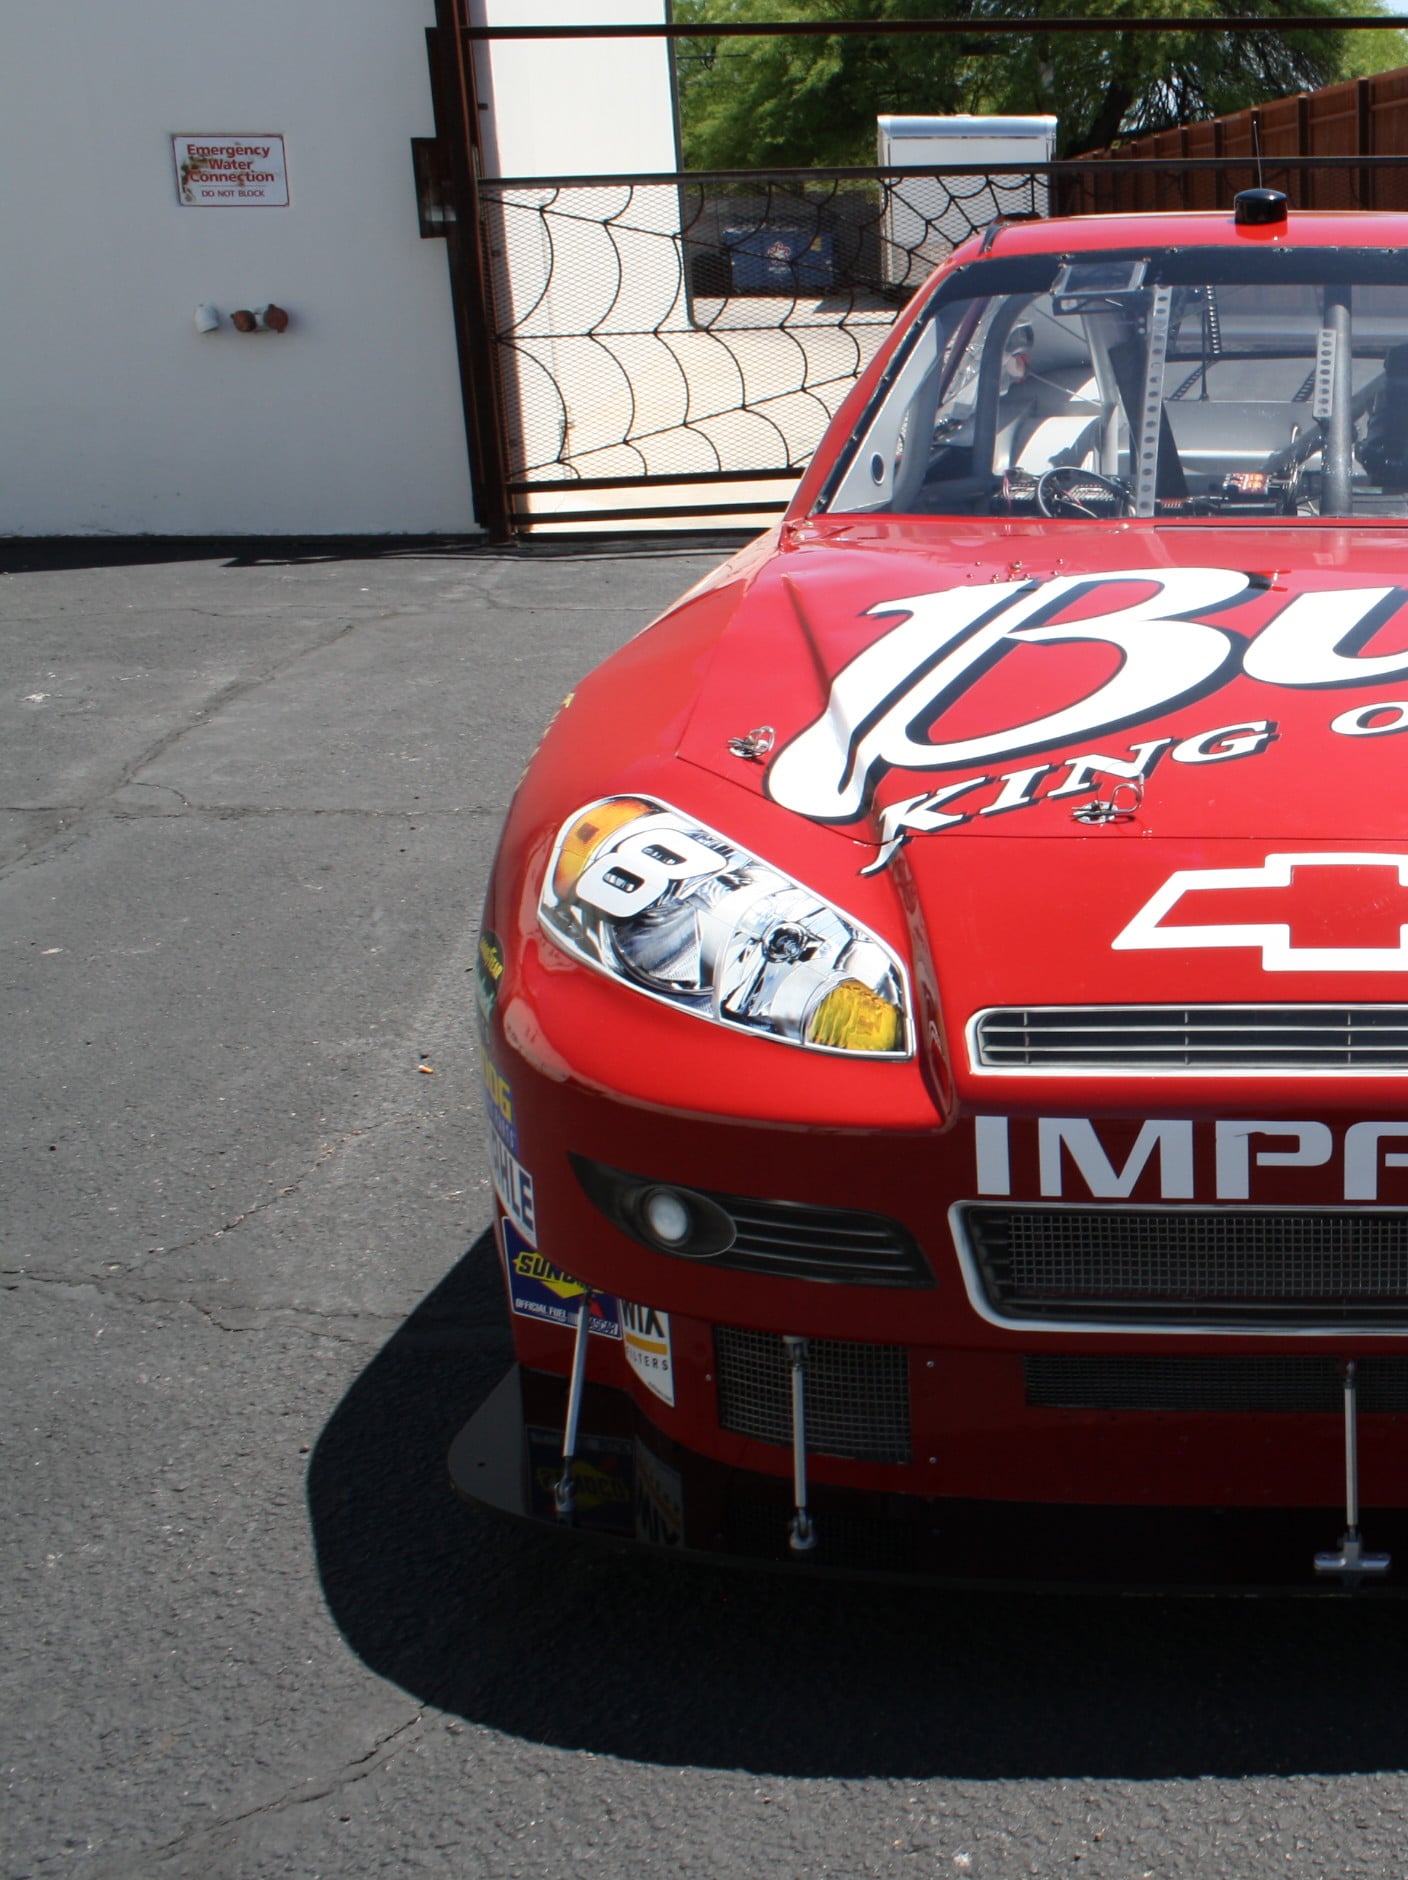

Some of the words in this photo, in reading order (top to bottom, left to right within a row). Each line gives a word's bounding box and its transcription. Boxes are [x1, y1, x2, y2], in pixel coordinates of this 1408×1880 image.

[186, 144, 270, 158] Emergency
[208, 159, 254, 170] Water
[189, 170, 275, 183] Connection
[201, 189, 215, 198] DO
[217, 189, 235, 198] NOT
[238, 189, 265, 198] BLOCK
[859, 720, 1278, 875] KING
[574, 827, 730, 919] 8
